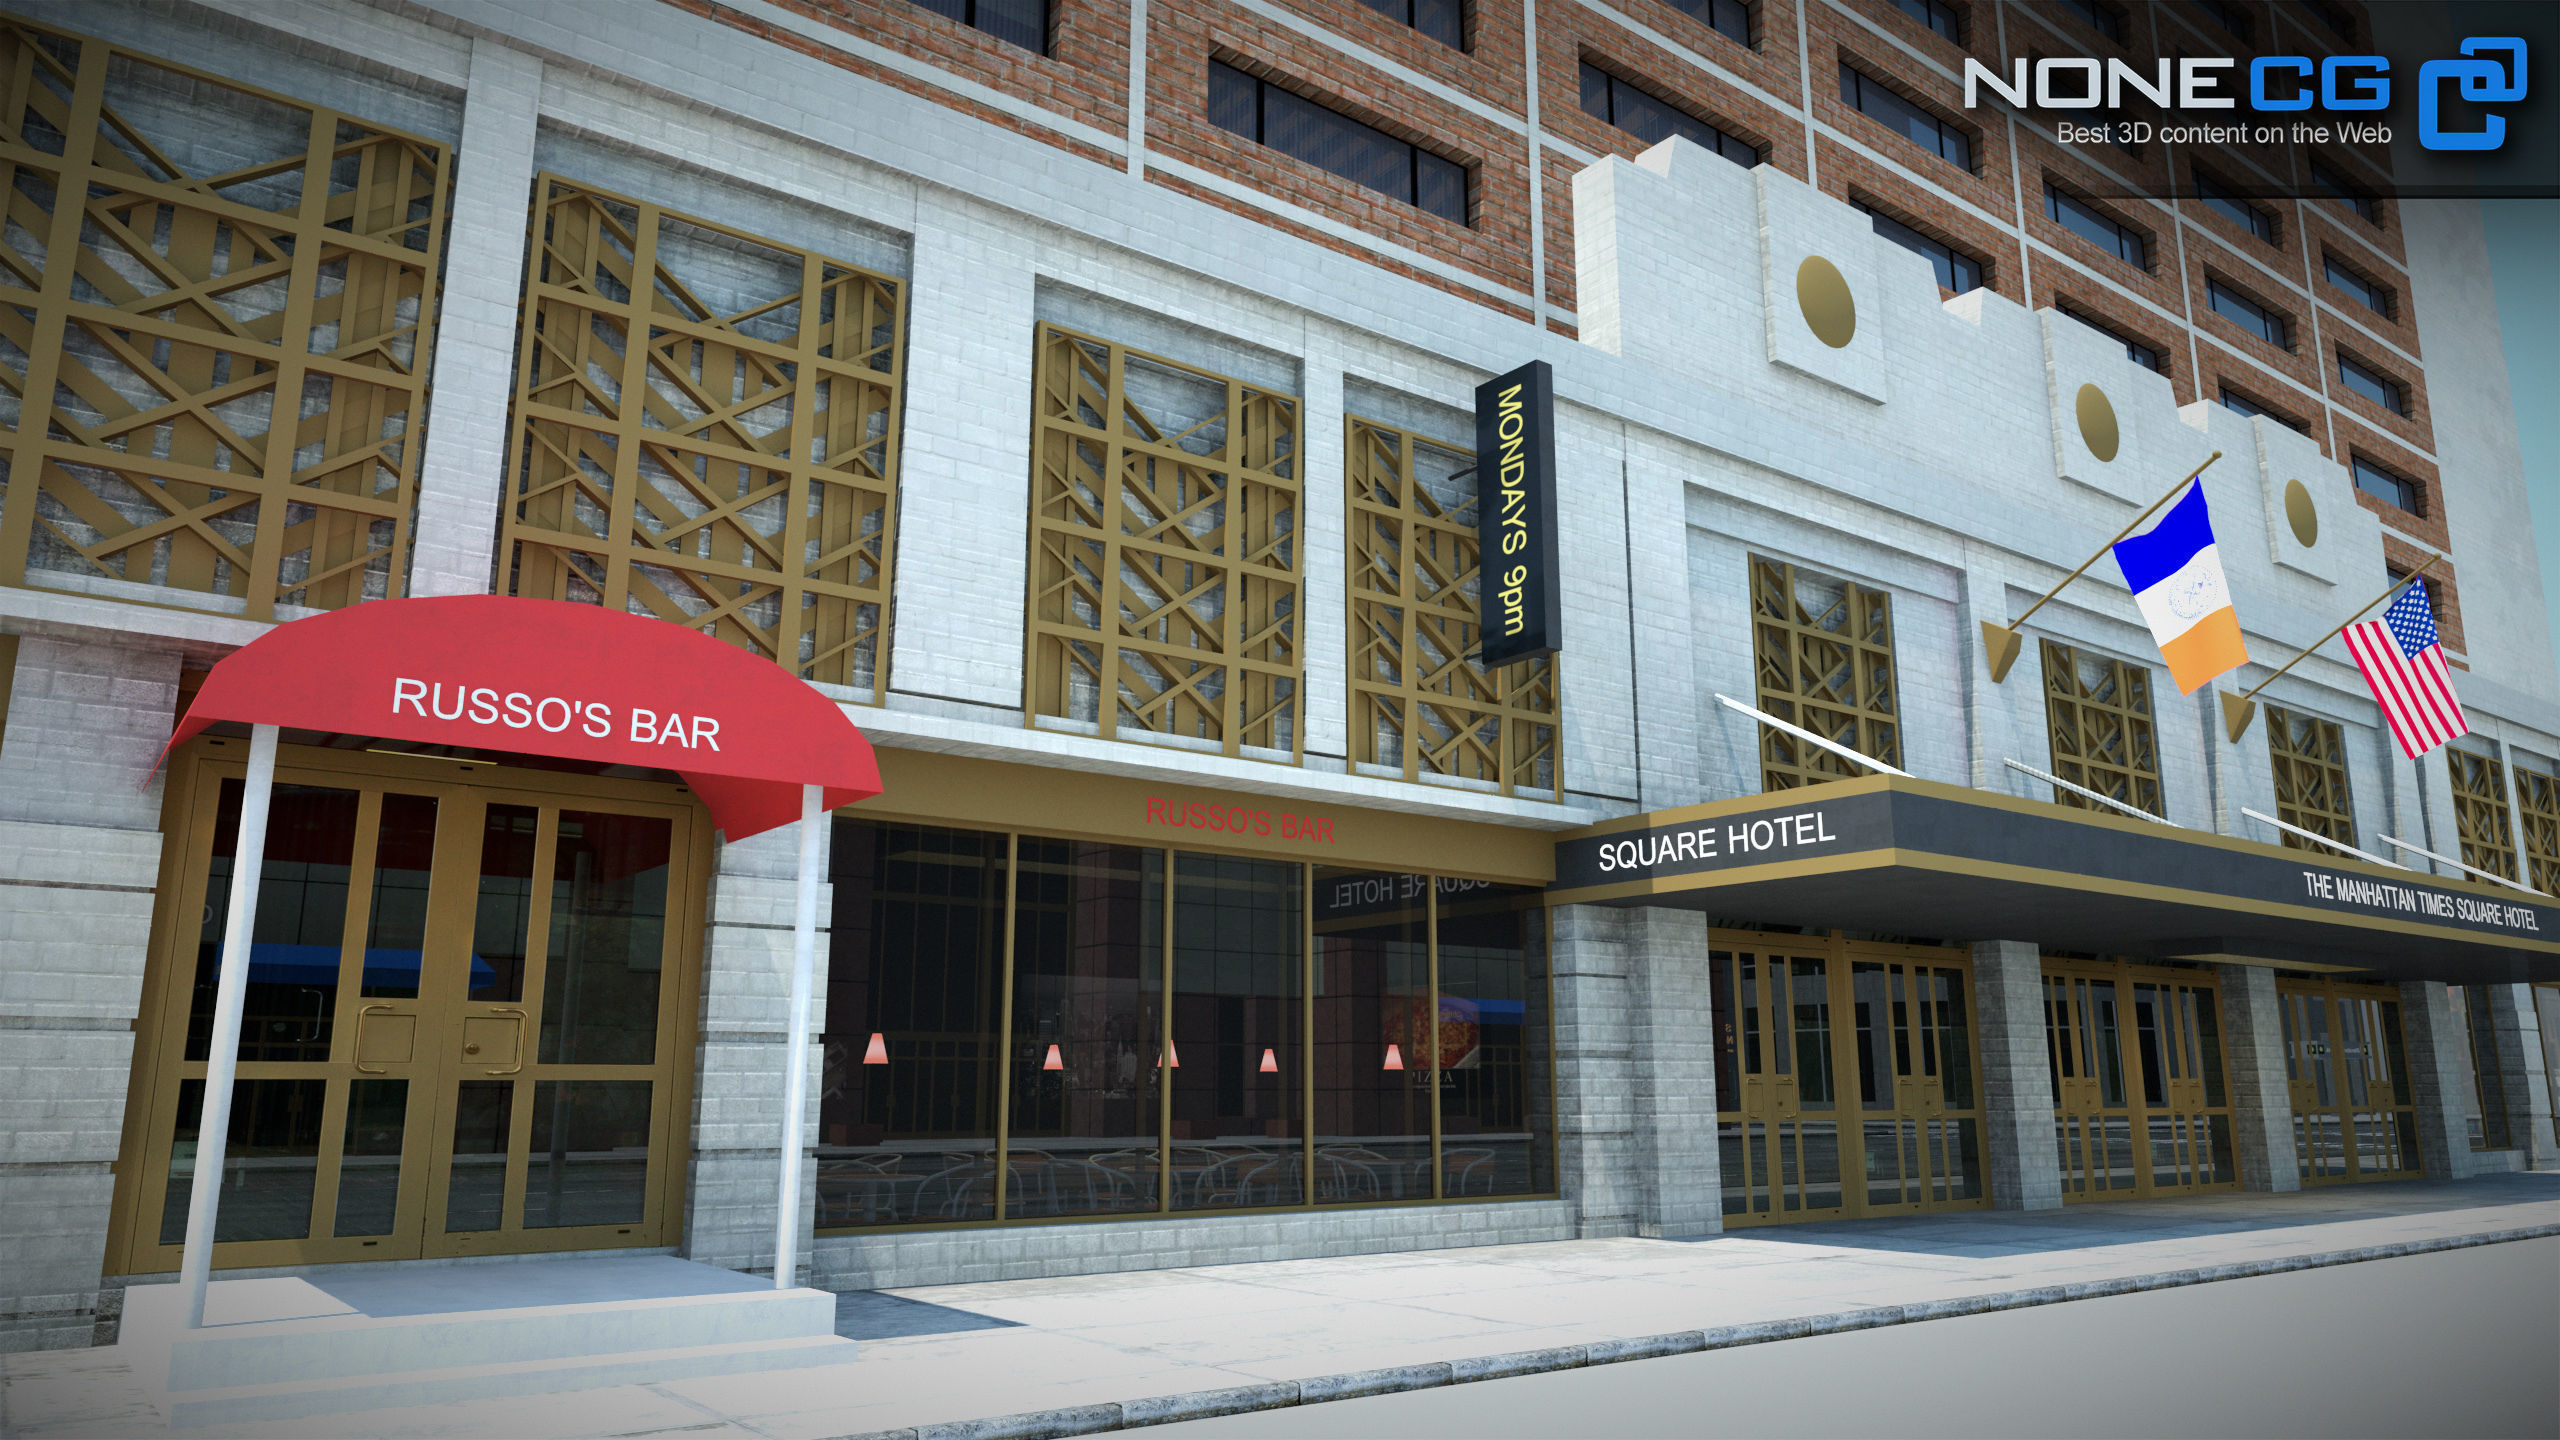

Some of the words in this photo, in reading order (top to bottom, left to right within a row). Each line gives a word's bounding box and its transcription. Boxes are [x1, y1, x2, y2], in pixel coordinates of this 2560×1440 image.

[1498, 383, 1527, 555] MONDAYS
[1498, 565, 1527, 637] 9pm
[392, 677, 612, 738] RUSSO'S
[630, 708, 720, 752] BAR
[1146, 797, 1271, 837] RUSSO'S
[1282, 814, 1335, 845] BAR
[1599, 827, 1718, 872] SQUARE
[1728, 812, 1836, 854] HOTEL
[2303, 871, 2334, 900] THE
[2335, 876, 2416, 913] MANHATTAN
[2417, 891, 2455, 918] TIMES
[2456, 897, 2504, 926] SQUARE
[2505, 906, 2540, 931] HOTEL
